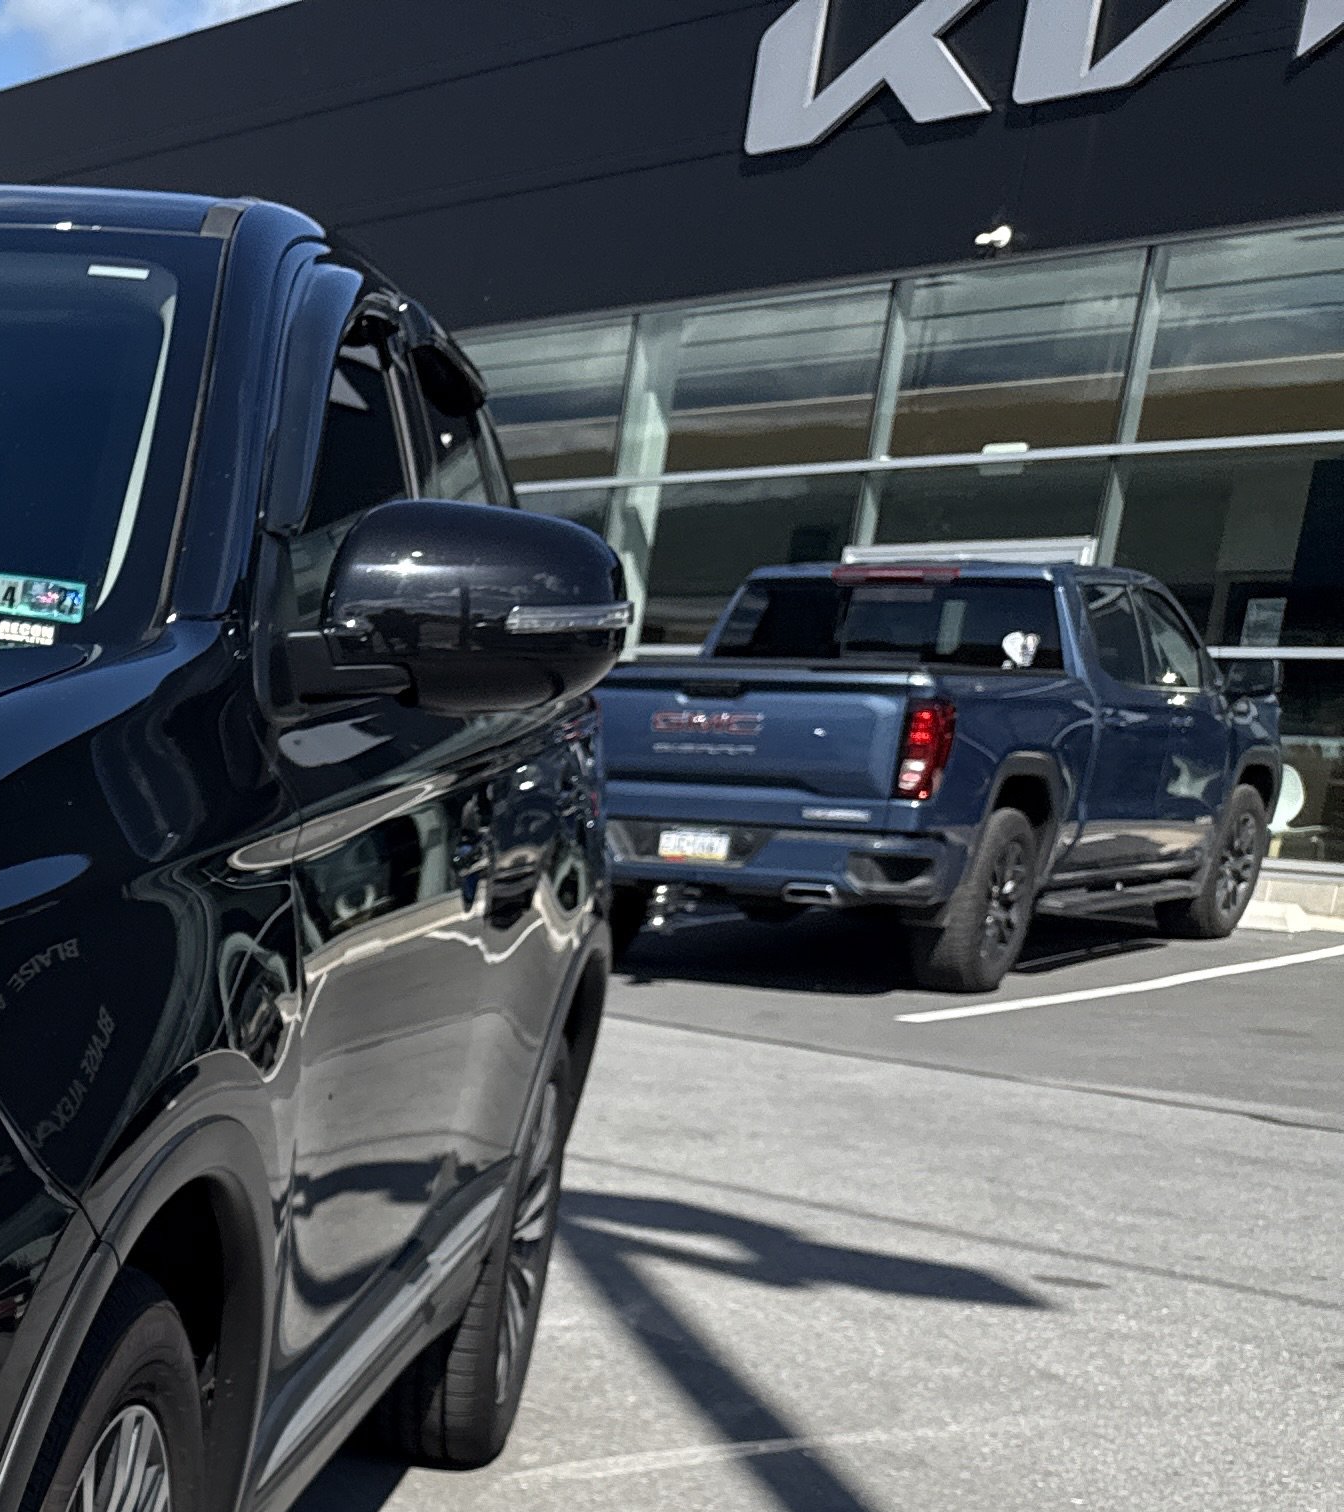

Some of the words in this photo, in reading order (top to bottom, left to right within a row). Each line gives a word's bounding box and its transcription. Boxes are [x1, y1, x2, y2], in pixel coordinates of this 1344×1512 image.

[1, 585, 17, 609] 4
[653, 711, 765, 735] GMC
[5, 937, 81, 993] BLAISE
